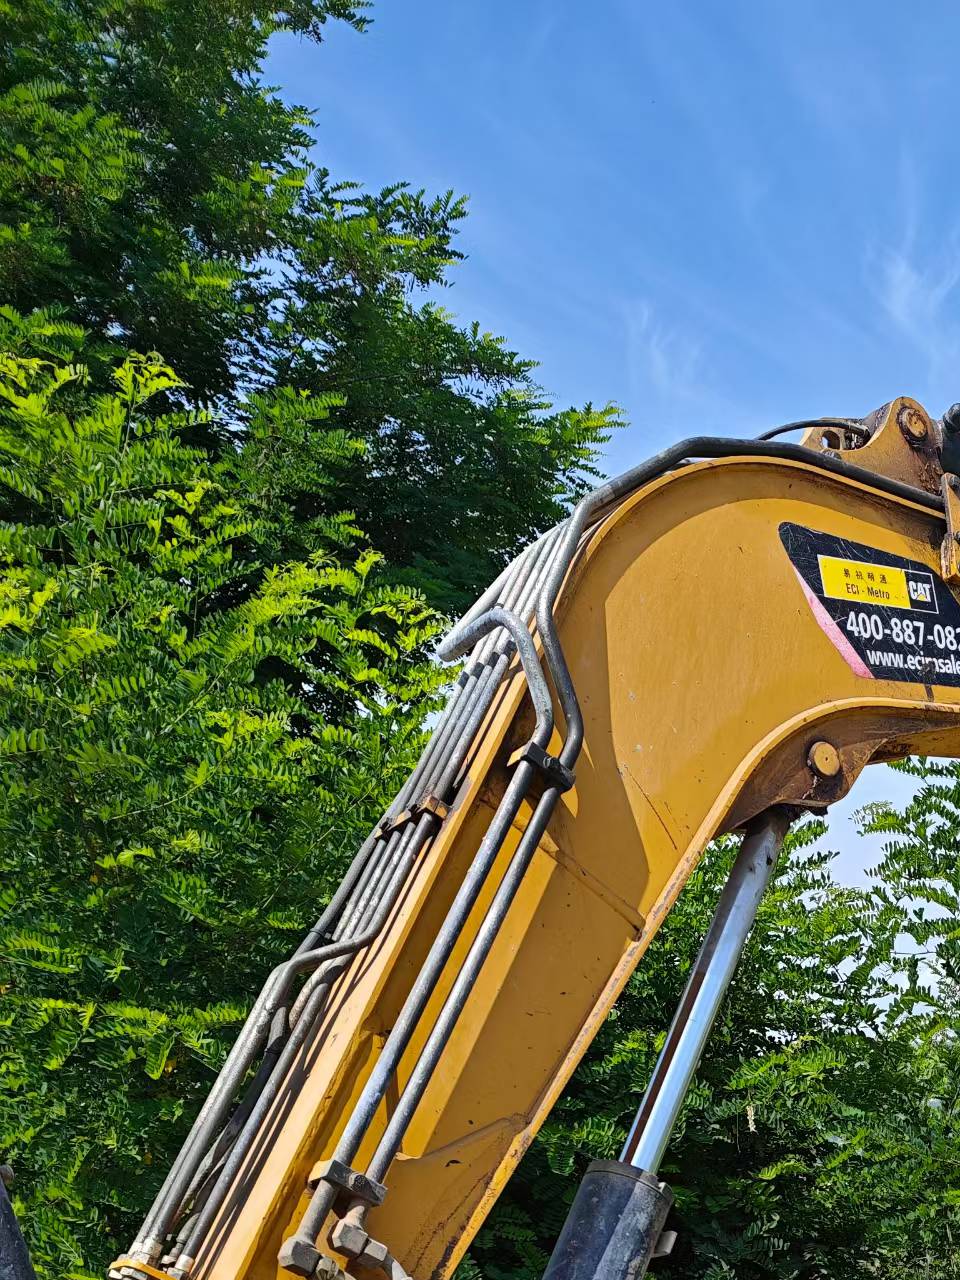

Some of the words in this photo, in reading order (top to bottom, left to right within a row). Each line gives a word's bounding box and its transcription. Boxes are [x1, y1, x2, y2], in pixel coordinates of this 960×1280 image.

[845, 583, 860, 595] ECI
[867, 586, 890, 600] Metro
[908, 580, 932, 603] CAT
